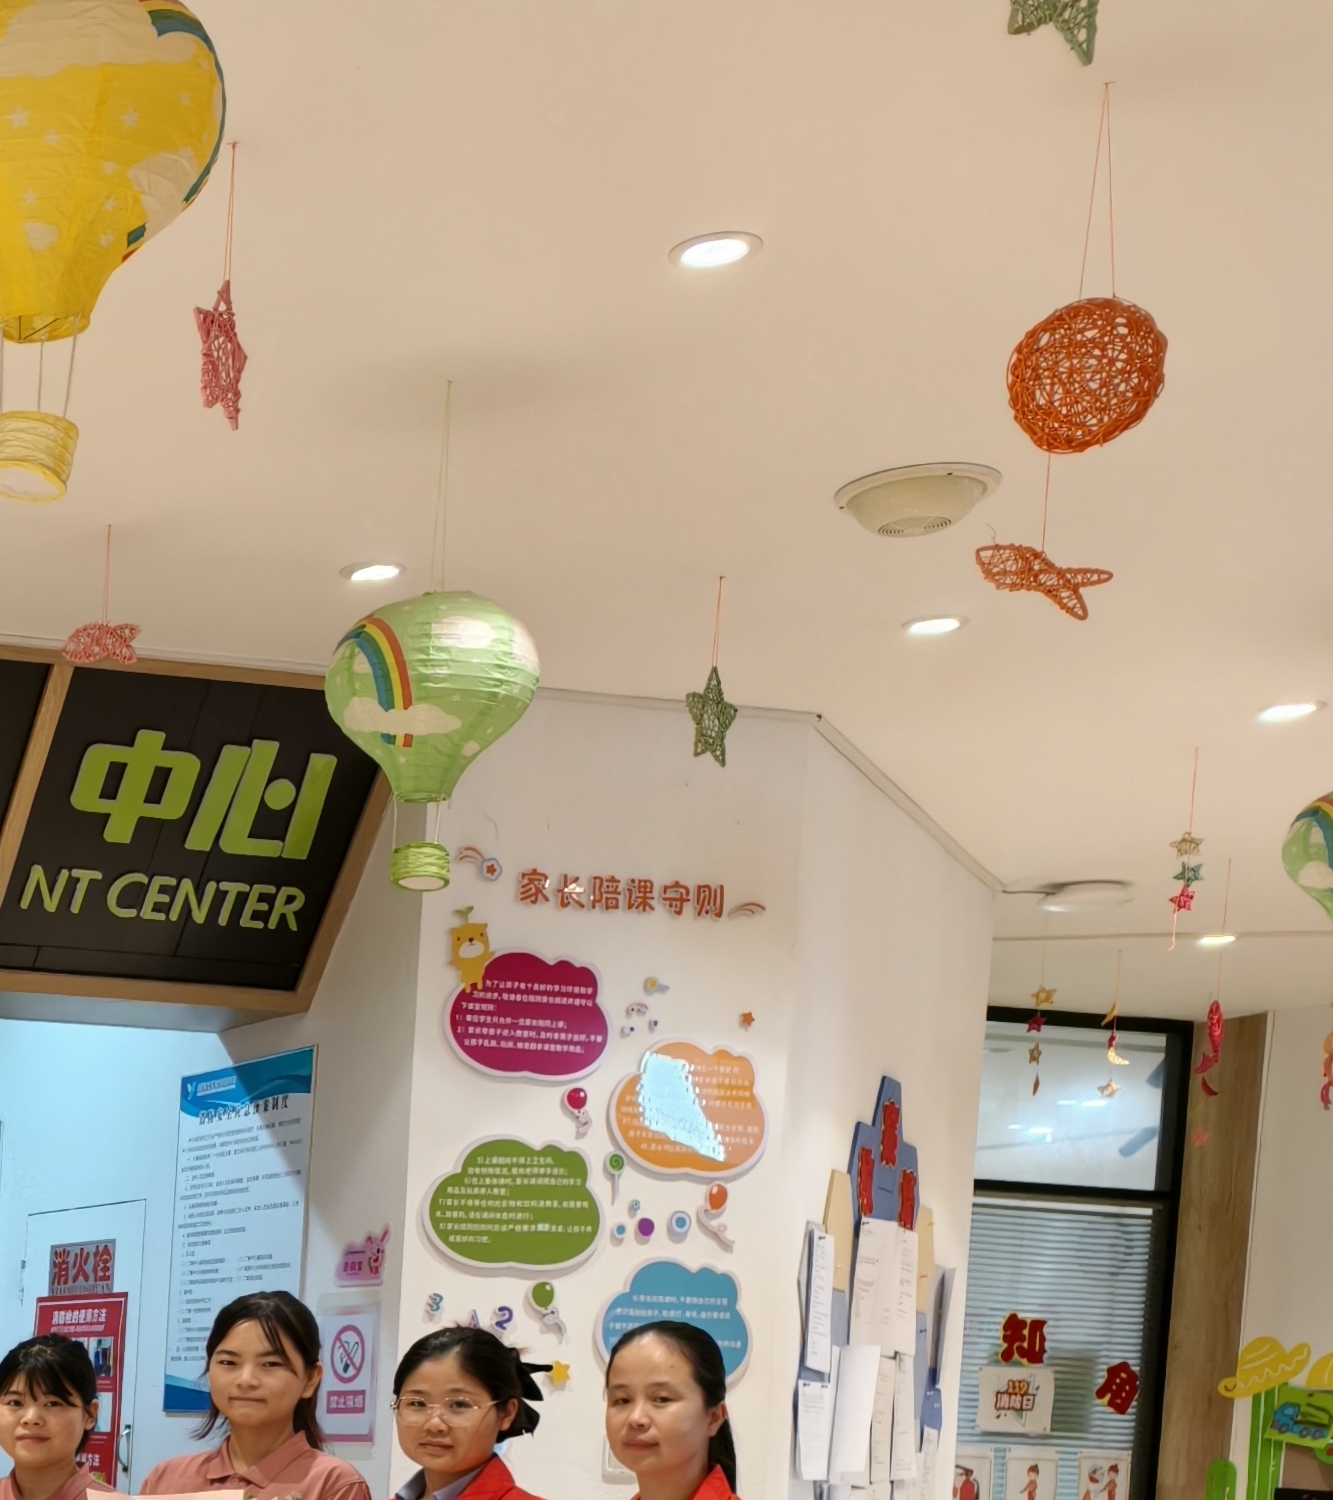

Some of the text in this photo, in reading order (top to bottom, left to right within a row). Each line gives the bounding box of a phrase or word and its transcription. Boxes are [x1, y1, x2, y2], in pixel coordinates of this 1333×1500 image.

[69, 728, 338, 861] 中心
[18, 864, 96, 914] NT
[105, 872, 306, 932] CENTER
[517, 868, 726, 918] 家长陪课守则
[52, 1244, 113, 1287] 消火栓
[999, 1312, 1048, 1366] 知
